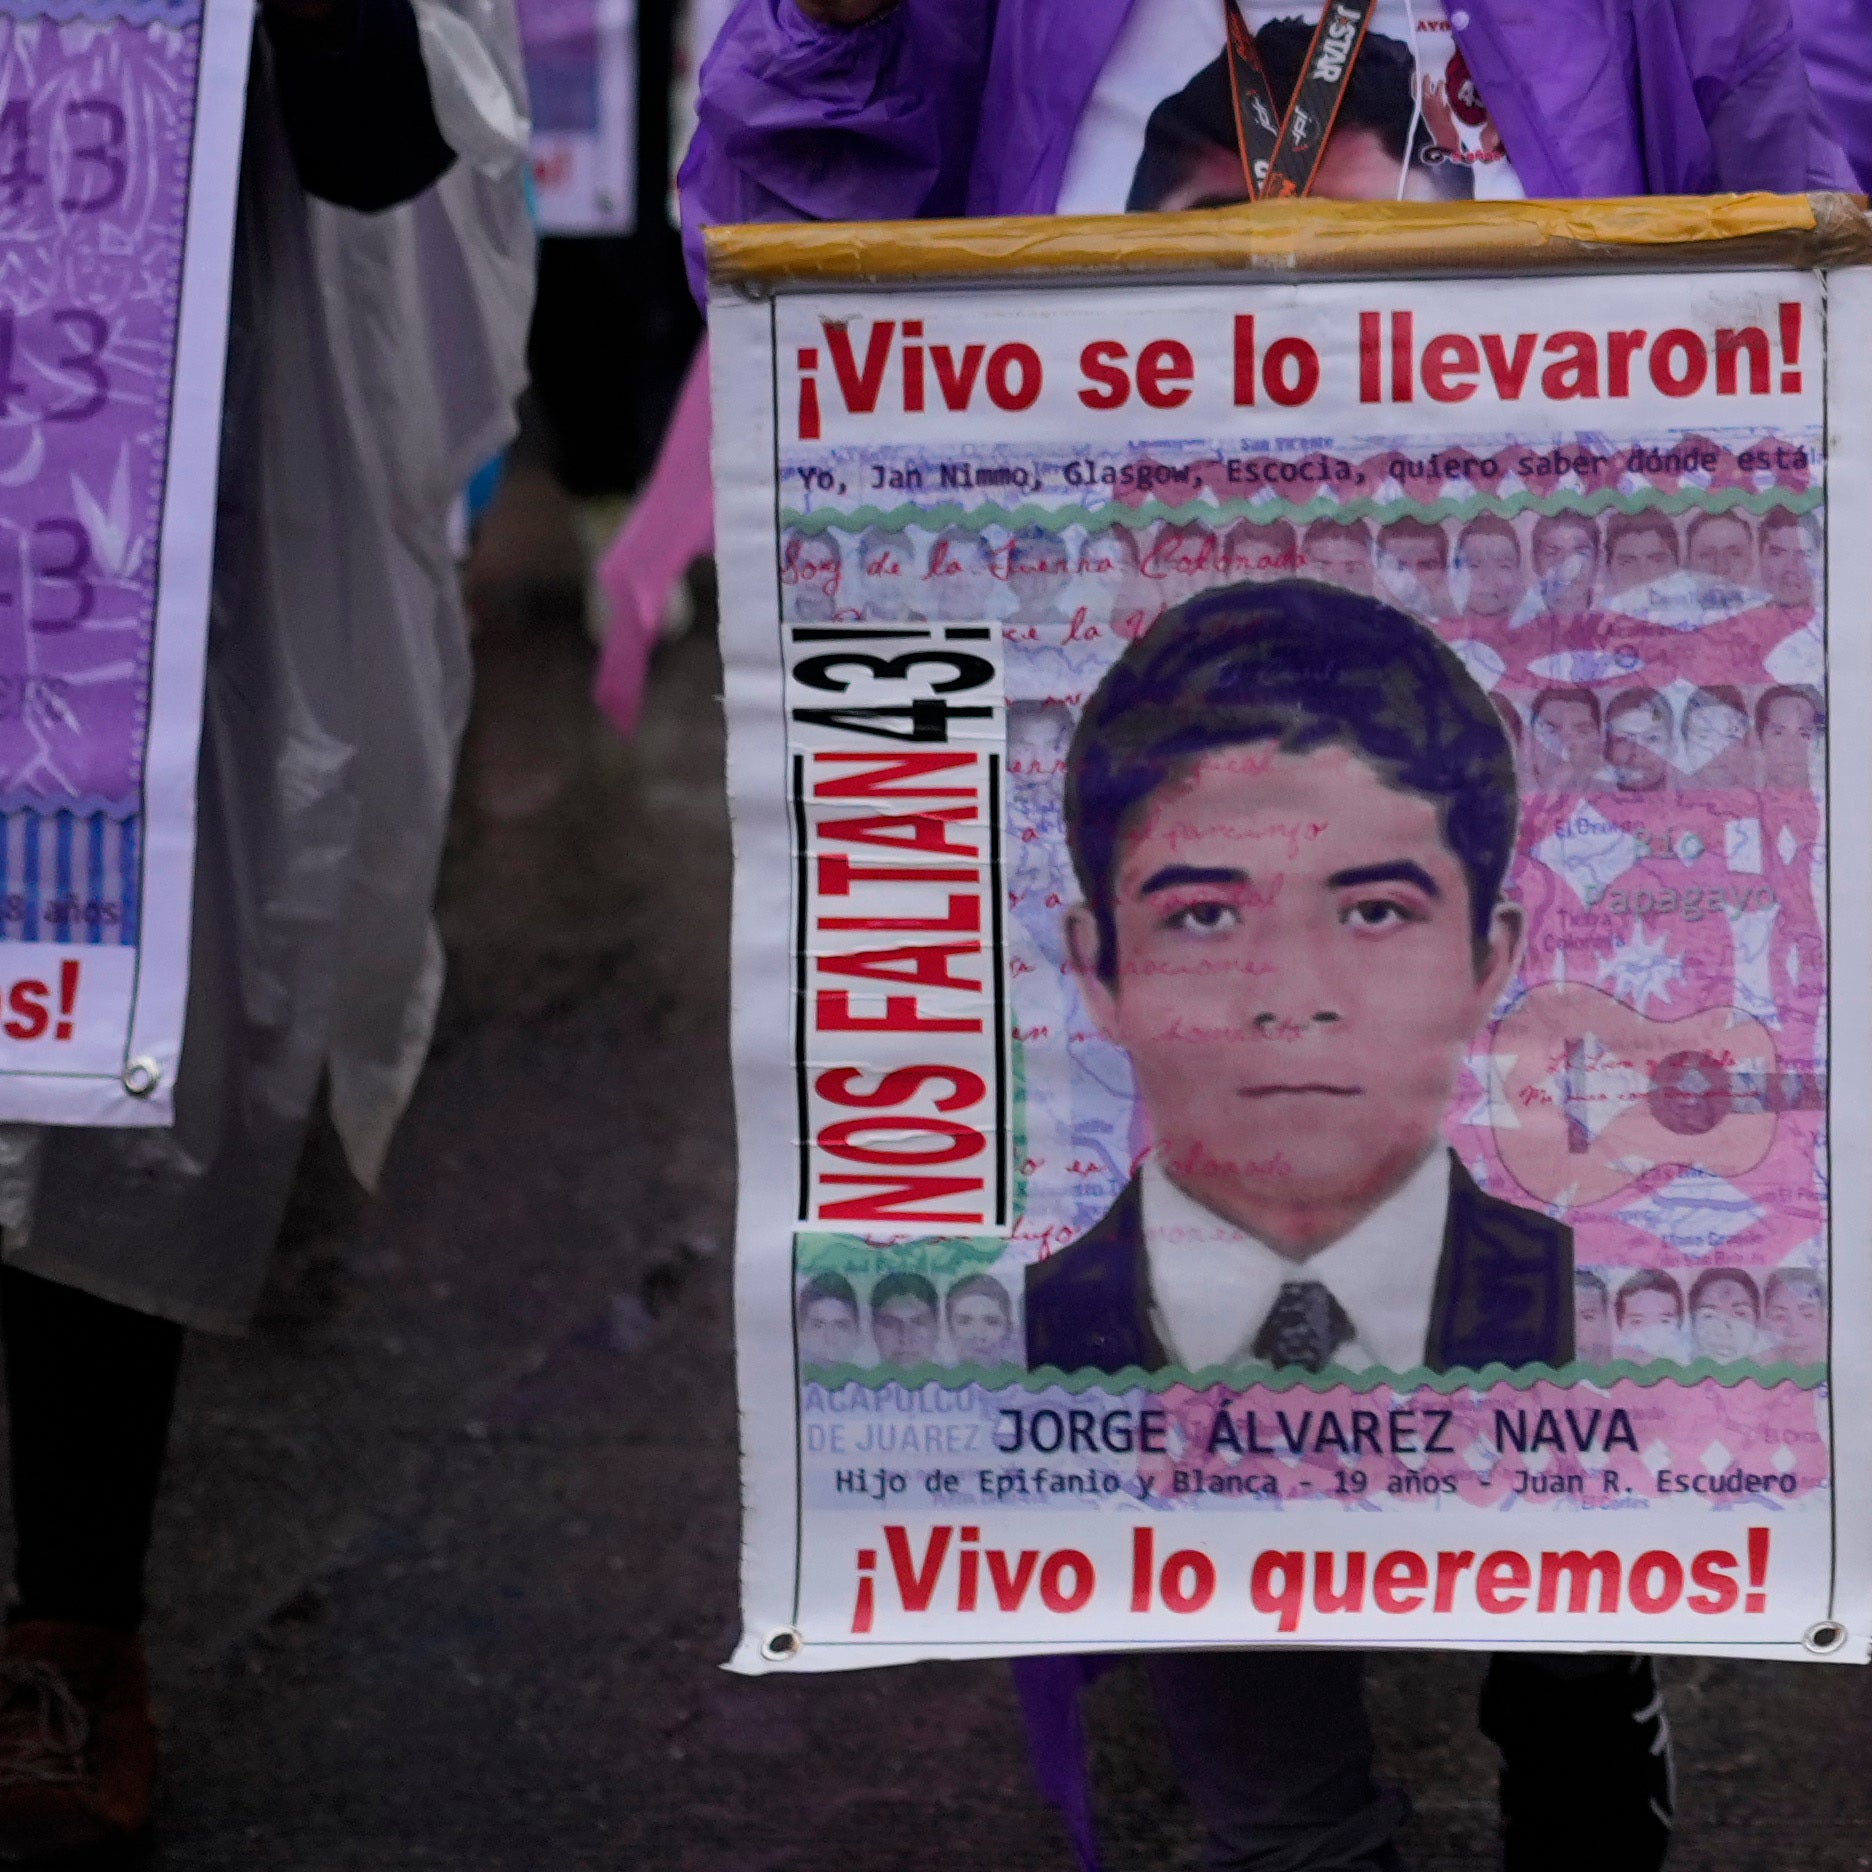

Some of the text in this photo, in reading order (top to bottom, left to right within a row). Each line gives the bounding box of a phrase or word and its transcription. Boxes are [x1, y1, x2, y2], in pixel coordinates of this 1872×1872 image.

[798, 302, 1803, 440] ¡Vivo se lo llevaron!
[798, 443, 1809, 494] Yo, Jan Nimmo, Glasgow, Escocia, quiero saber dónde está
[792, 628, 996, 1224] NOS FALTAN 43!
[998, 1399, 1640, 1455] JORGE ÁLVAREZ NAVA
[836, 1468, 1797, 1499] Hijo de Epifanio y Blanca 19 años Juan R. Escudero
[851, 1525, 1771, 1633] ¡Vivo lo queremos!
